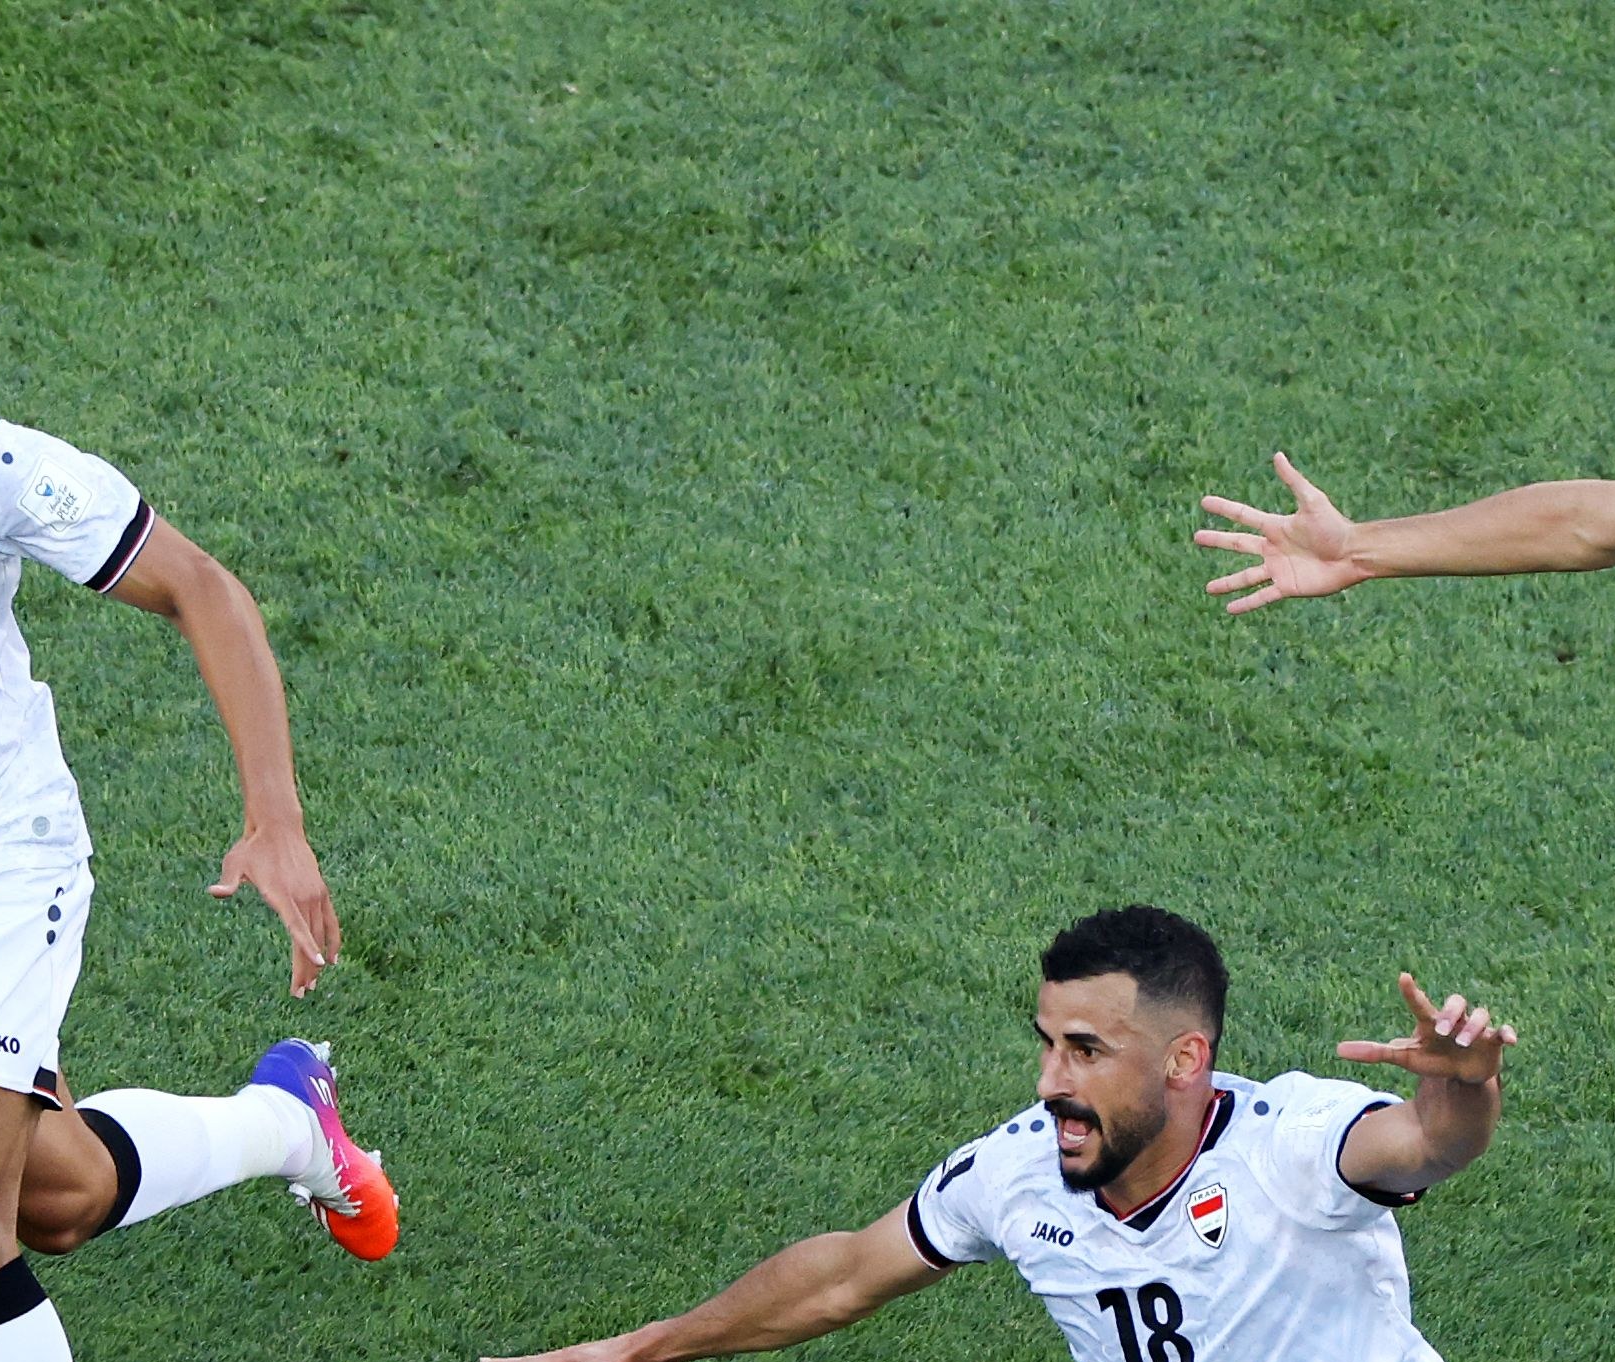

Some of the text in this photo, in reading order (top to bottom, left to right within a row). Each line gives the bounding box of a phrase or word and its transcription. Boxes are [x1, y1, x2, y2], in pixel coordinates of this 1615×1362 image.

[56, 490, 78, 521] PEACE
[1194, 1188, 1217, 1201] IRAQ
[1030, 1221, 1075, 1247] JAKO
